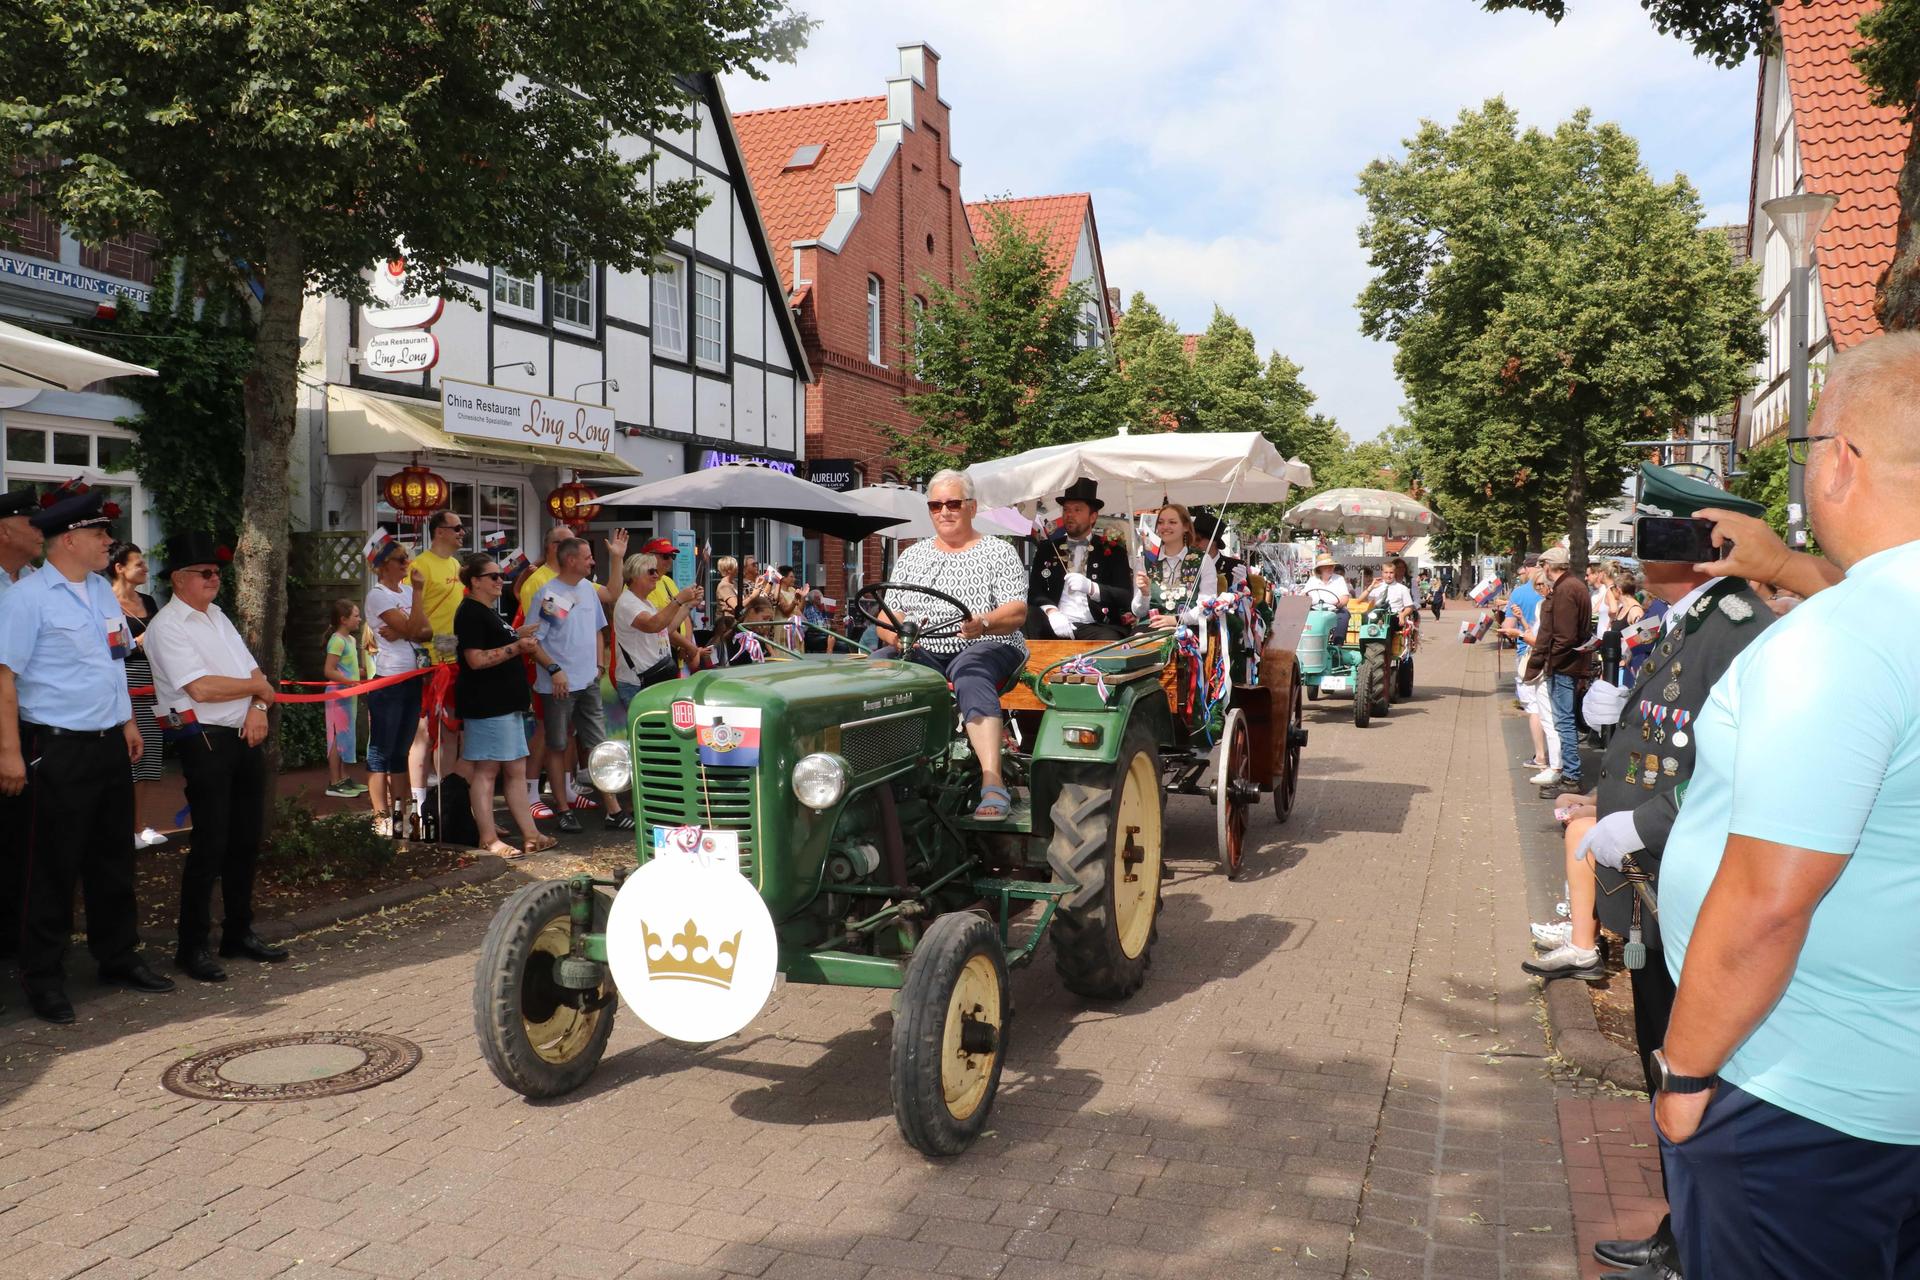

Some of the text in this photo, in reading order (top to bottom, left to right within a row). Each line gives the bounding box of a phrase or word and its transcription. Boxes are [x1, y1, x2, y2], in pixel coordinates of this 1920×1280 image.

[13, 260, 72, 286] WILHELM
[76, 276, 100, 292] UNS
[371, 337, 428, 347] China Restaurant
[371, 347, 427, 367] Ling Long
[447, 393, 521, 416] China Restaurant
[522, 399, 610, 451] Ling Long
[811, 472, 850, 483] AURELIO'S
[674, 704, 694, 724] HELA
